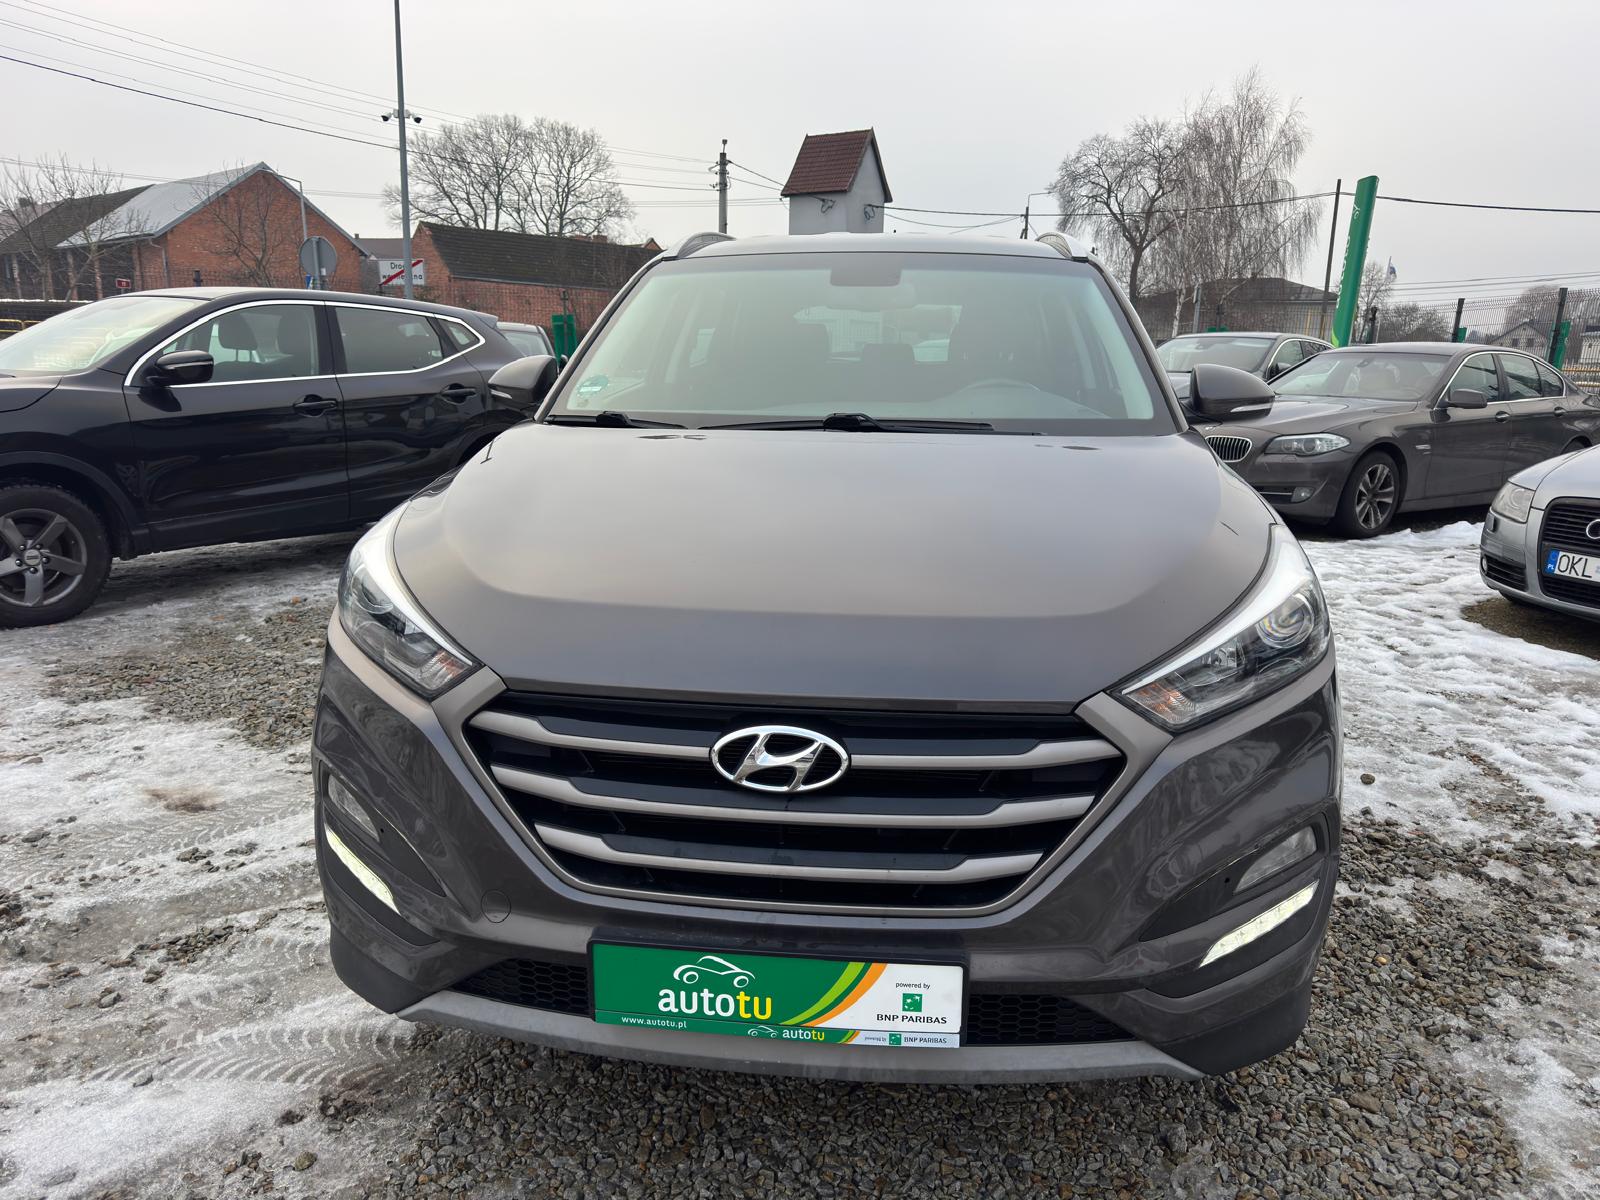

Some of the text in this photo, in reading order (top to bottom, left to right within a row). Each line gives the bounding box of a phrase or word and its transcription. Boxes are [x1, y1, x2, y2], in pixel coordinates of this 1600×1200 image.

[1557, 554, 1592, 578] OKL
[658, 988, 772, 1020] autotu
[621, 1016, 687, 1029] www.autotu.pl
[876, 1013, 947, 1025] BNP PARIBAS
[782, 1029, 825, 1041] autotu
[919, 1036, 947, 1044] PARIBAS
